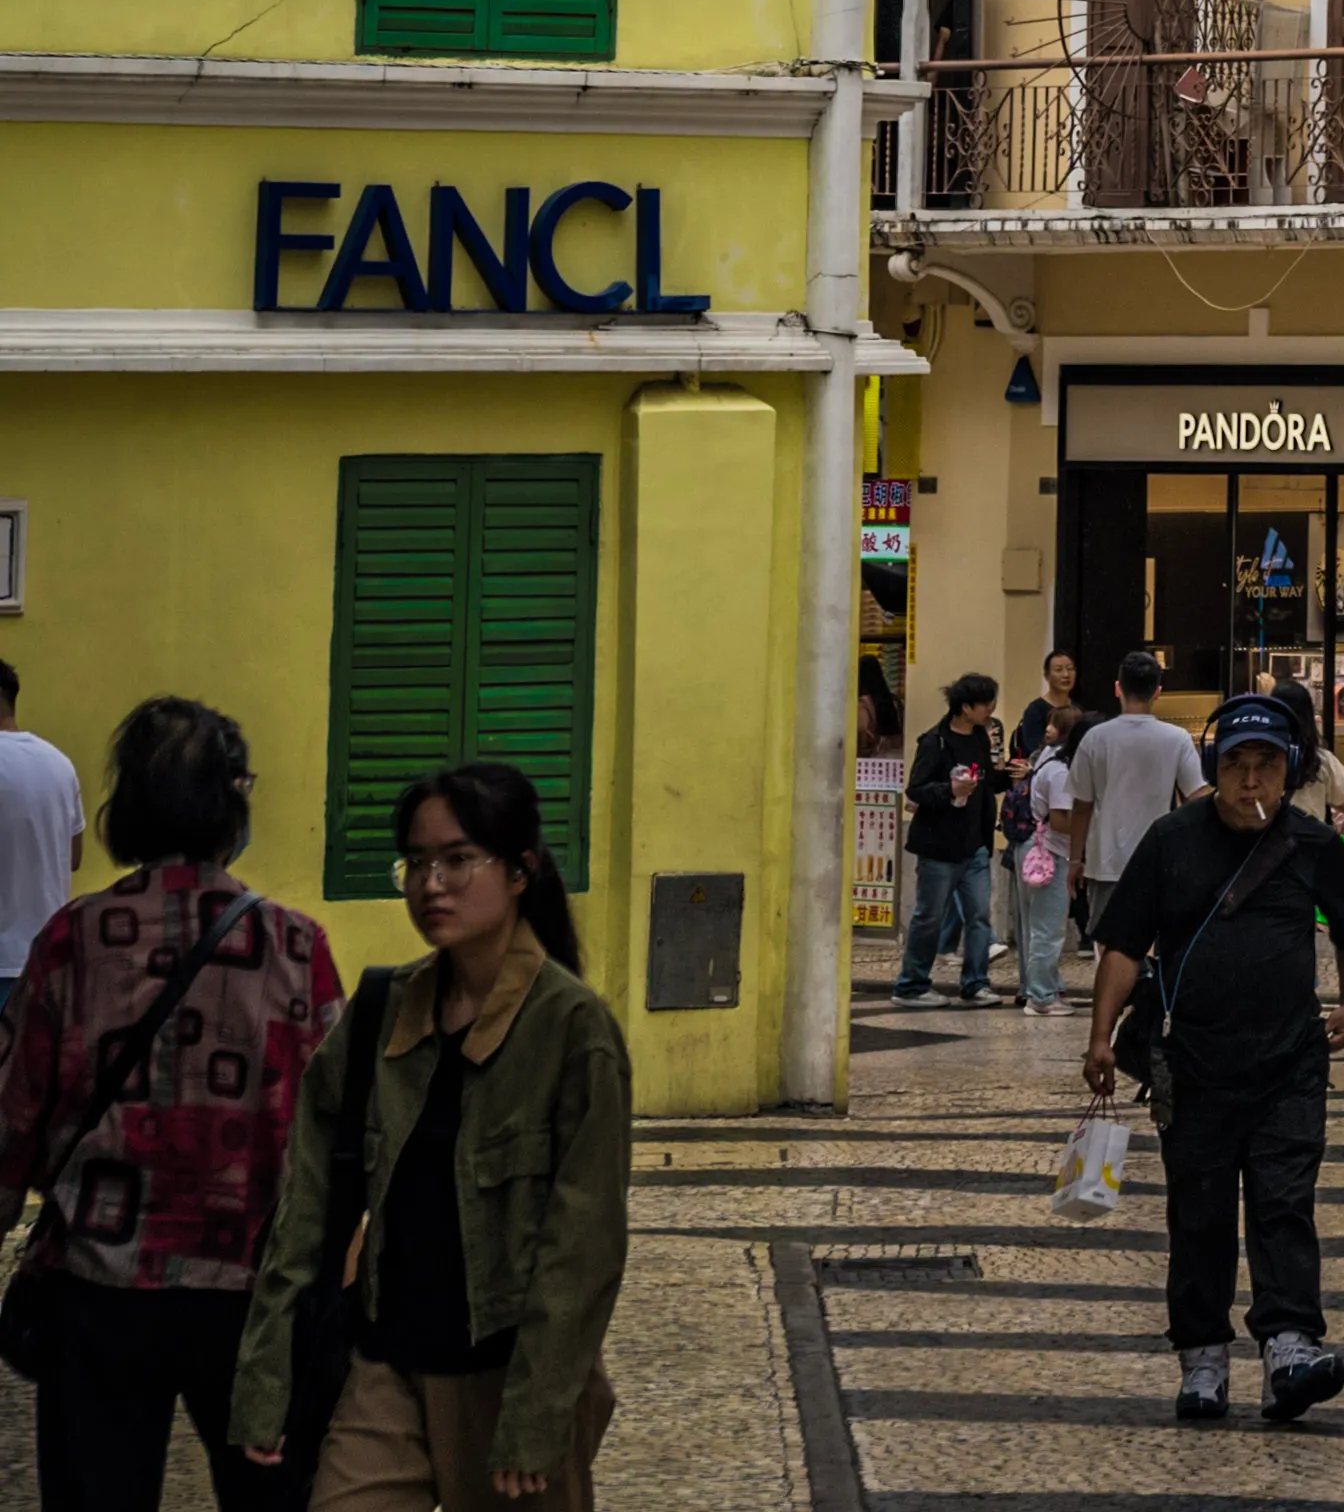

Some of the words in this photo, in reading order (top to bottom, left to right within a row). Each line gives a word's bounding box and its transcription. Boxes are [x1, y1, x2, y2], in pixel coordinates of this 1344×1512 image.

[253, 178, 711, 314] FANCL
[1178, 409, 1332, 453] PANDORA
[1245, 585, 1277, 599] YOUR
[1279, 585, 1305, 598] WAY
